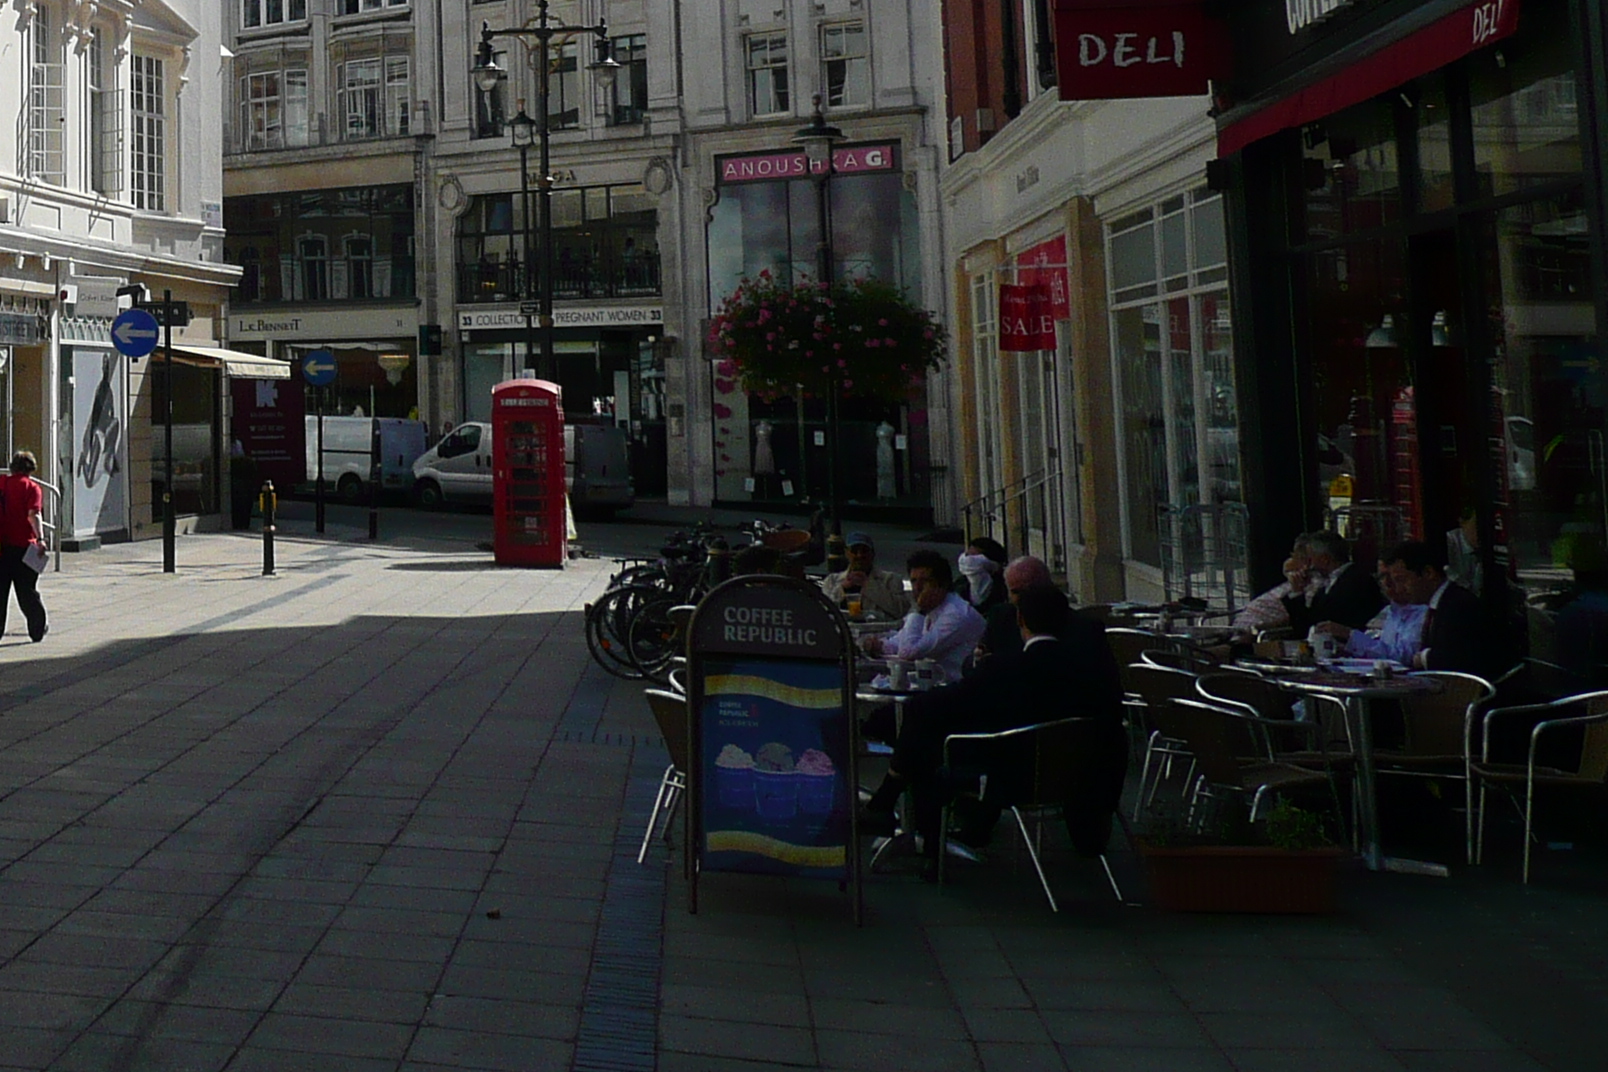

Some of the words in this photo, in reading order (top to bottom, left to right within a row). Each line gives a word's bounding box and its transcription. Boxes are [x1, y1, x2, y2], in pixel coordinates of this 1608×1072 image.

[1077, 30, 1186, 68] DELI
[462, 316, 472, 326] 33
[555, 311, 605, 323] PREGNANT
[607, 310, 647, 322] WOMEN
[650, 310, 661, 321] 33
[1001, 314, 1053, 336] SALE
[724, 606, 793, 626] COFFEE
[724, 625, 817, 646] REPUBLIC
